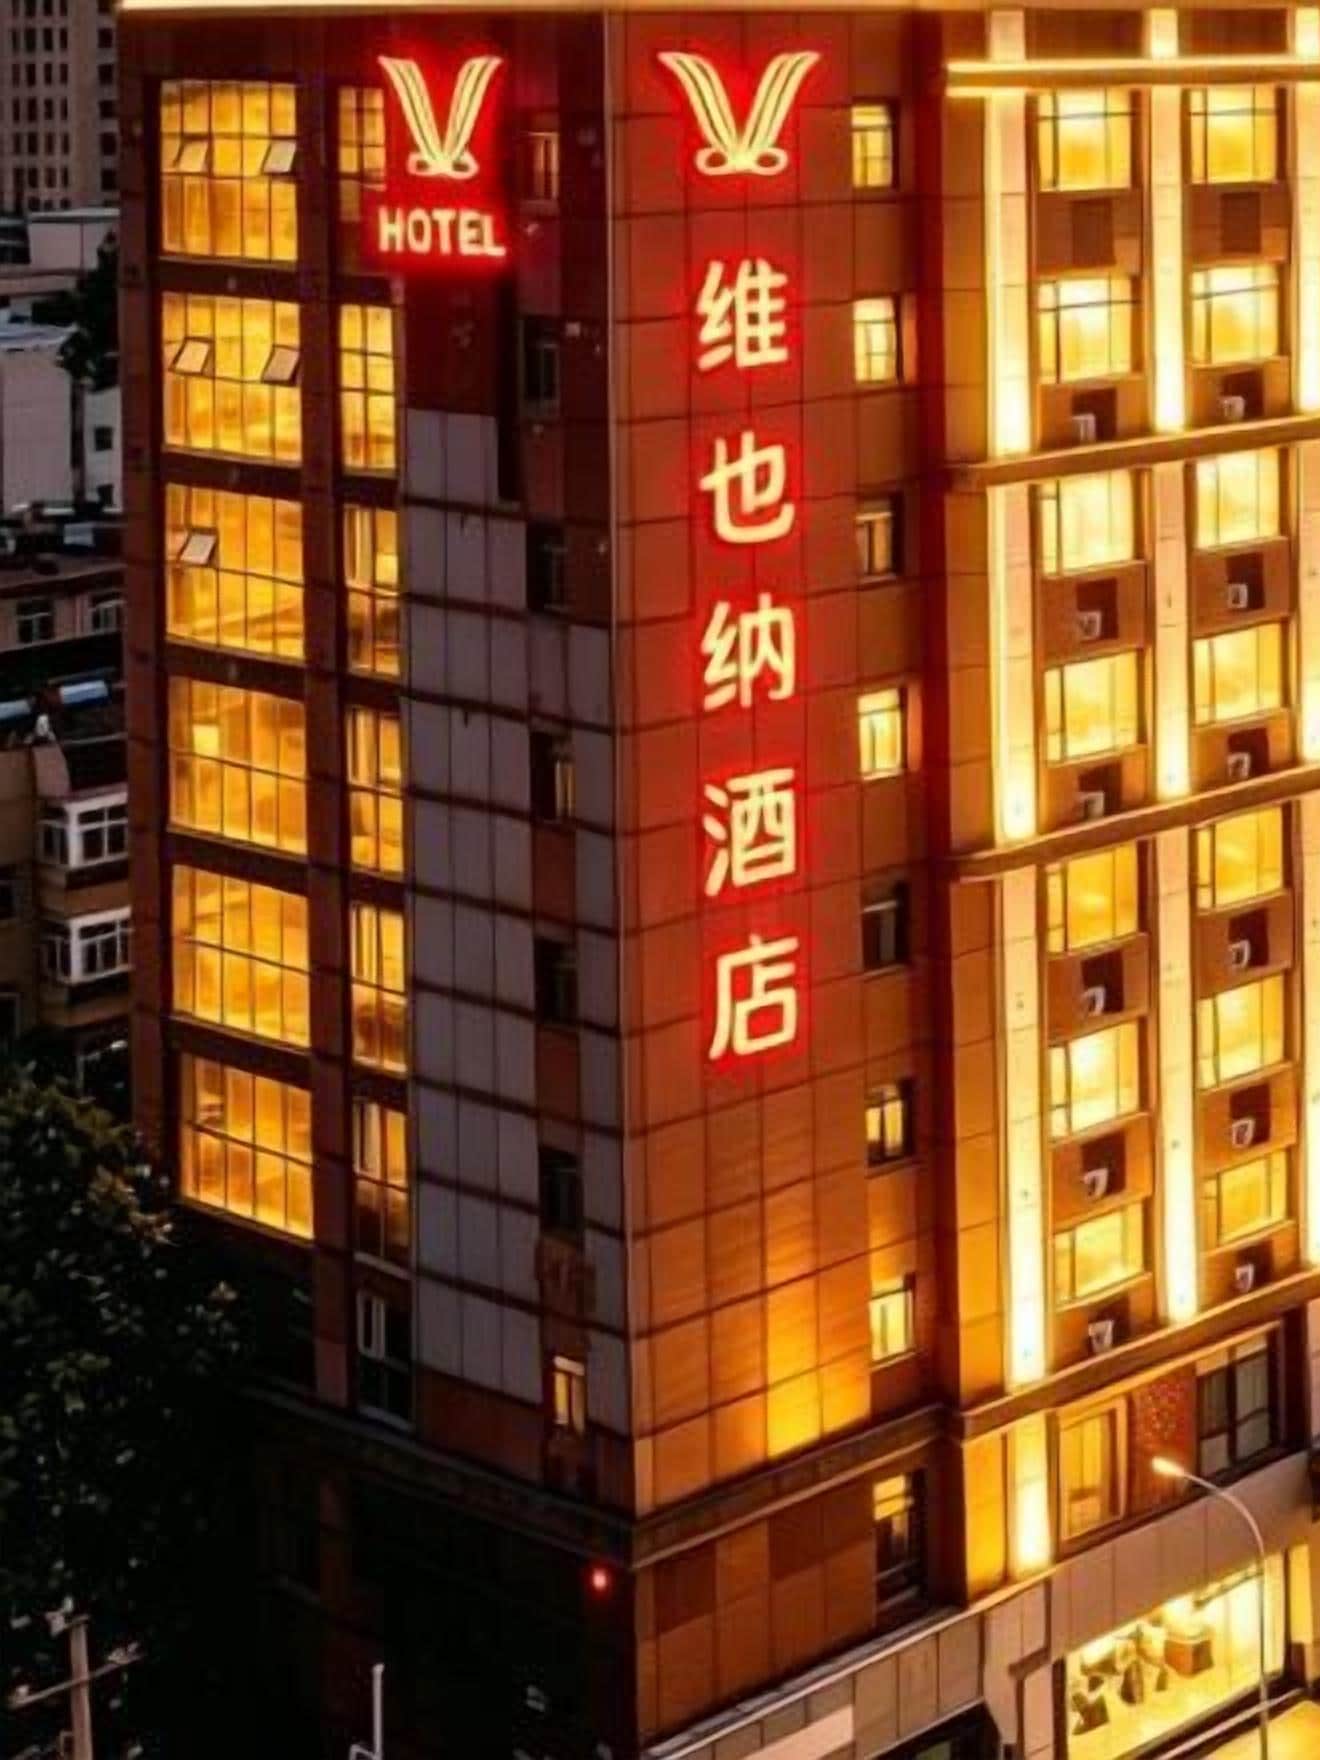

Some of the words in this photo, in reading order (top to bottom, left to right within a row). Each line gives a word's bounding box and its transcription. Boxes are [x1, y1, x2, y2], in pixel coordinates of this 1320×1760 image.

[377, 206, 507, 257] HOTEL
[696, 257, 799, 1060] 维也纳酒店
